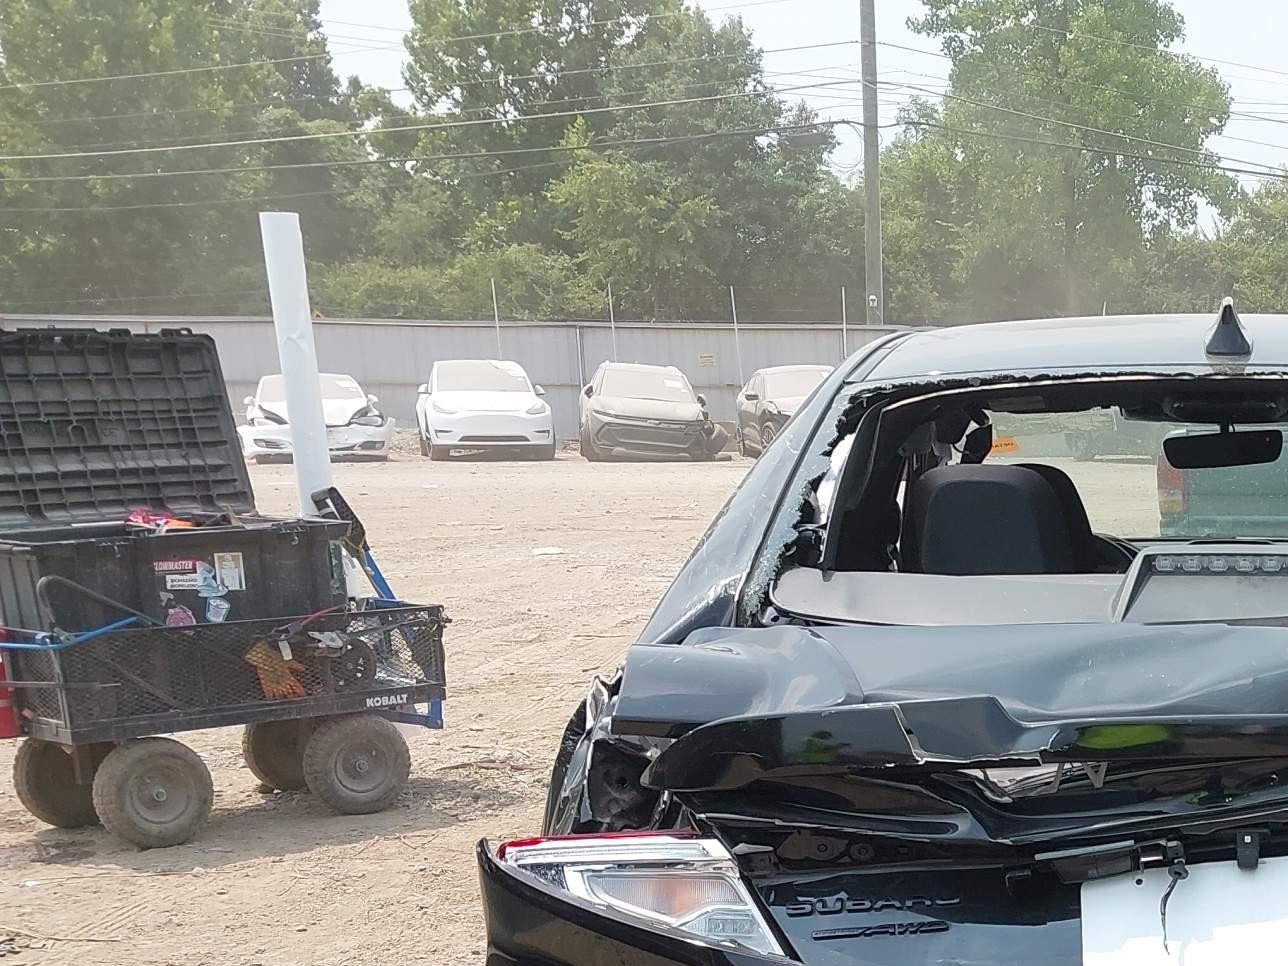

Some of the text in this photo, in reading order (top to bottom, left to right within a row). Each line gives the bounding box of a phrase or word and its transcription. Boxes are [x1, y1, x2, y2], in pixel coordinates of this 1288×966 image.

[366, 693, 408, 708] KOBALT
[785, 896, 961, 918] SUBARU
[860, 920, 950, 938] AWD
